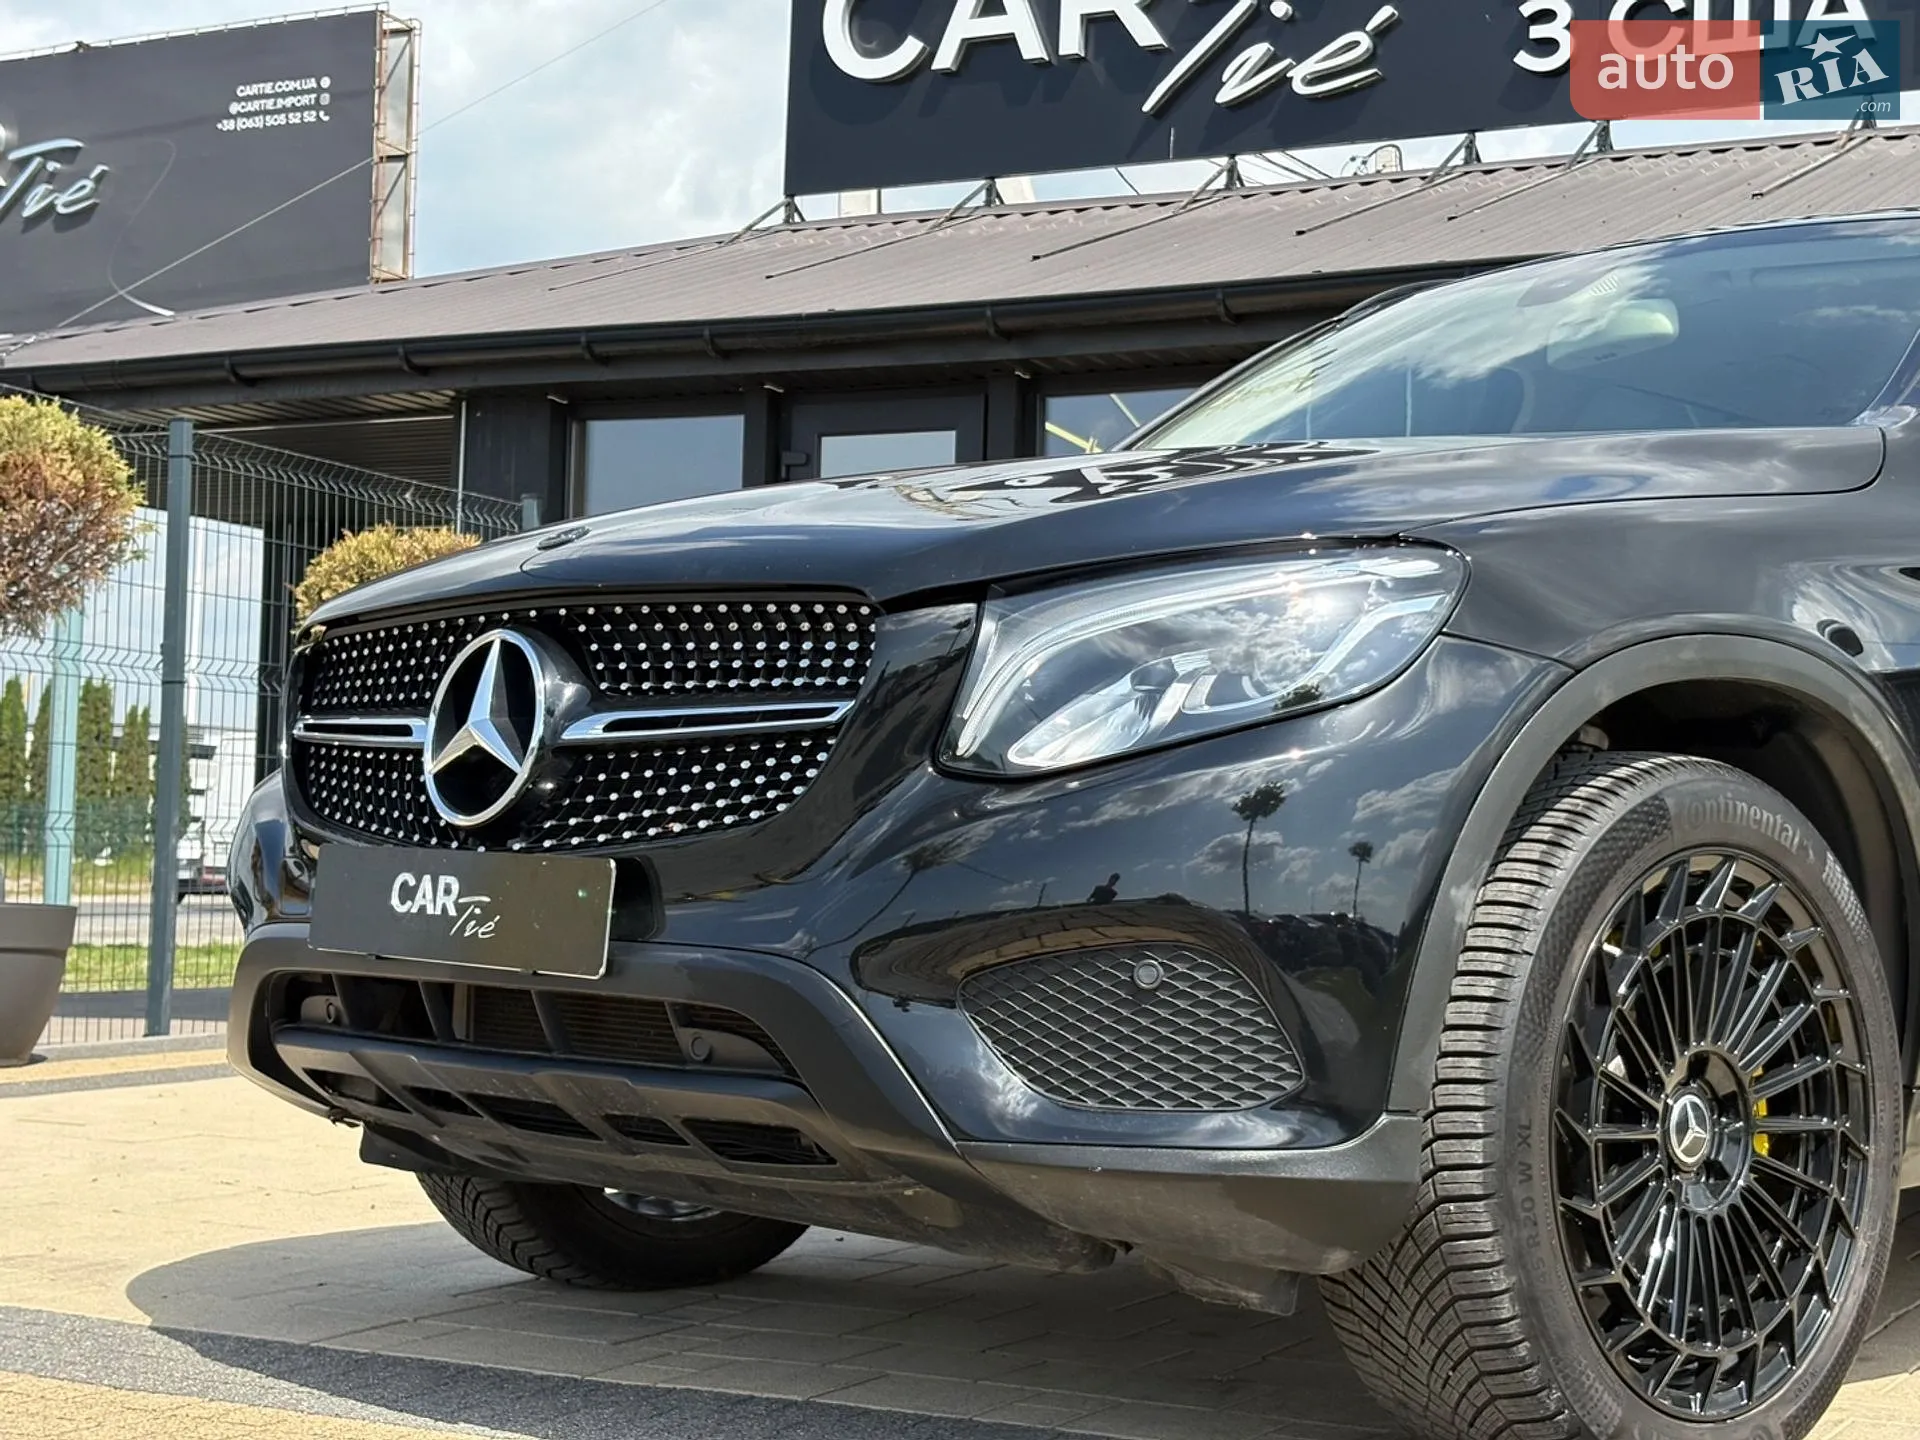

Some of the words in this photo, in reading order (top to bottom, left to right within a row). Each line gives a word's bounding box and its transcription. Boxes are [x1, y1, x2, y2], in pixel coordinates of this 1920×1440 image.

[235, 77, 318, 98] CARTIE.COM.UA
[390, 871, 461, 917] CAR
[1517, 1117, 1533, 1149] XL
[1517, 1160, 1534, 1185] W
